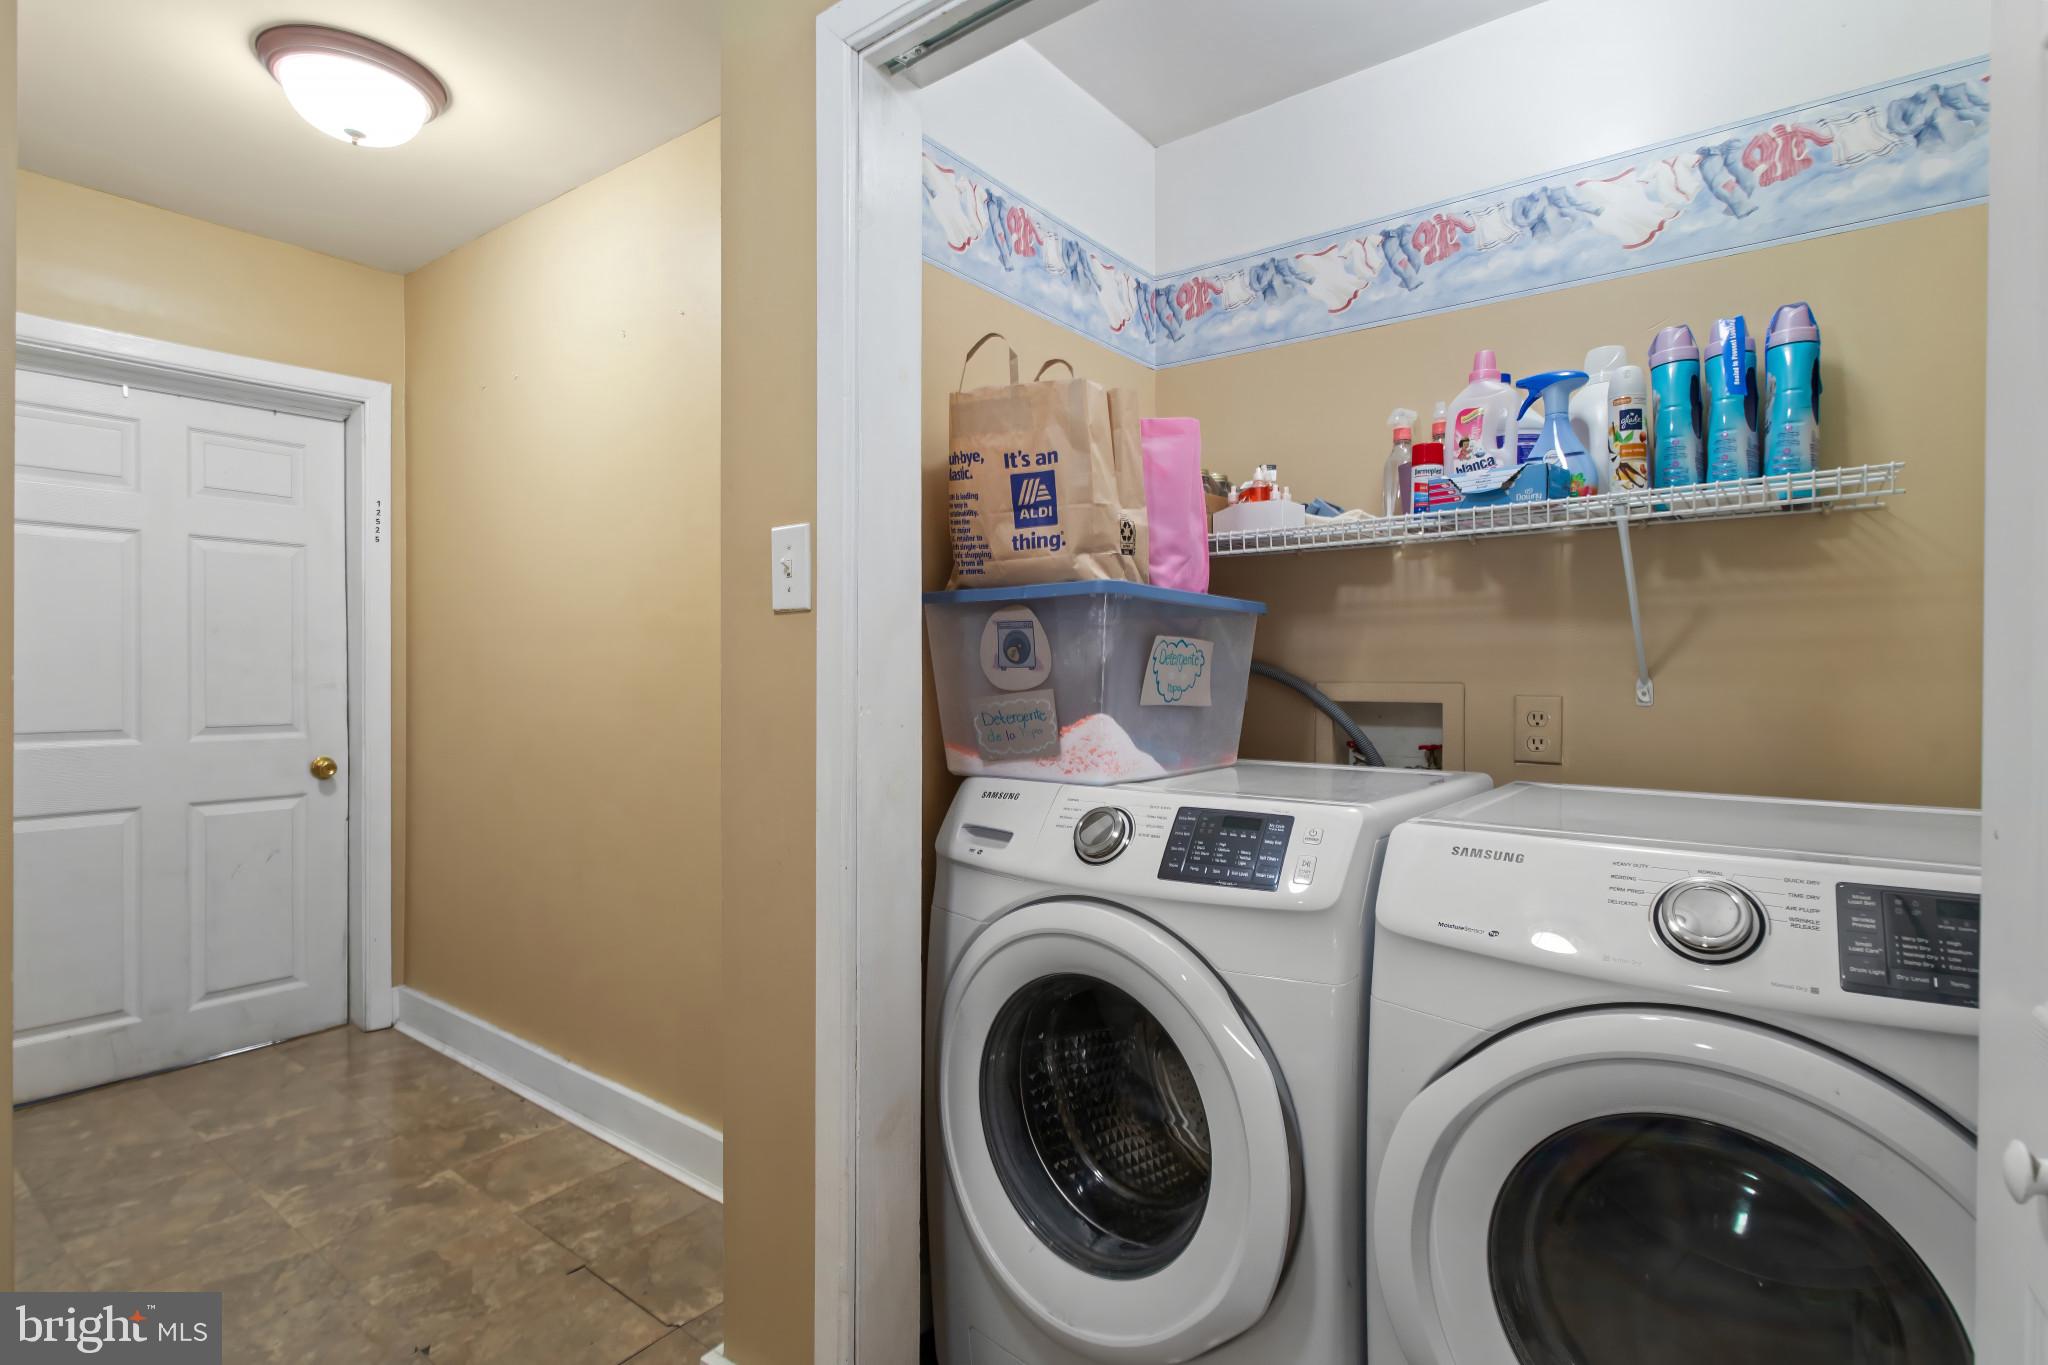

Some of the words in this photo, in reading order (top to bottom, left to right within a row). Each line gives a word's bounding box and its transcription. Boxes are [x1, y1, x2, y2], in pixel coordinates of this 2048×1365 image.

[1003, 450, 1031, 469] It's
[1035, 450, 1058, 466] an
[1020, 505, 1053, 519] ALDI
[981, 791, 1021, 801] SAMSUNG
[1451, 846, 1525, 864] SAMSUNG
